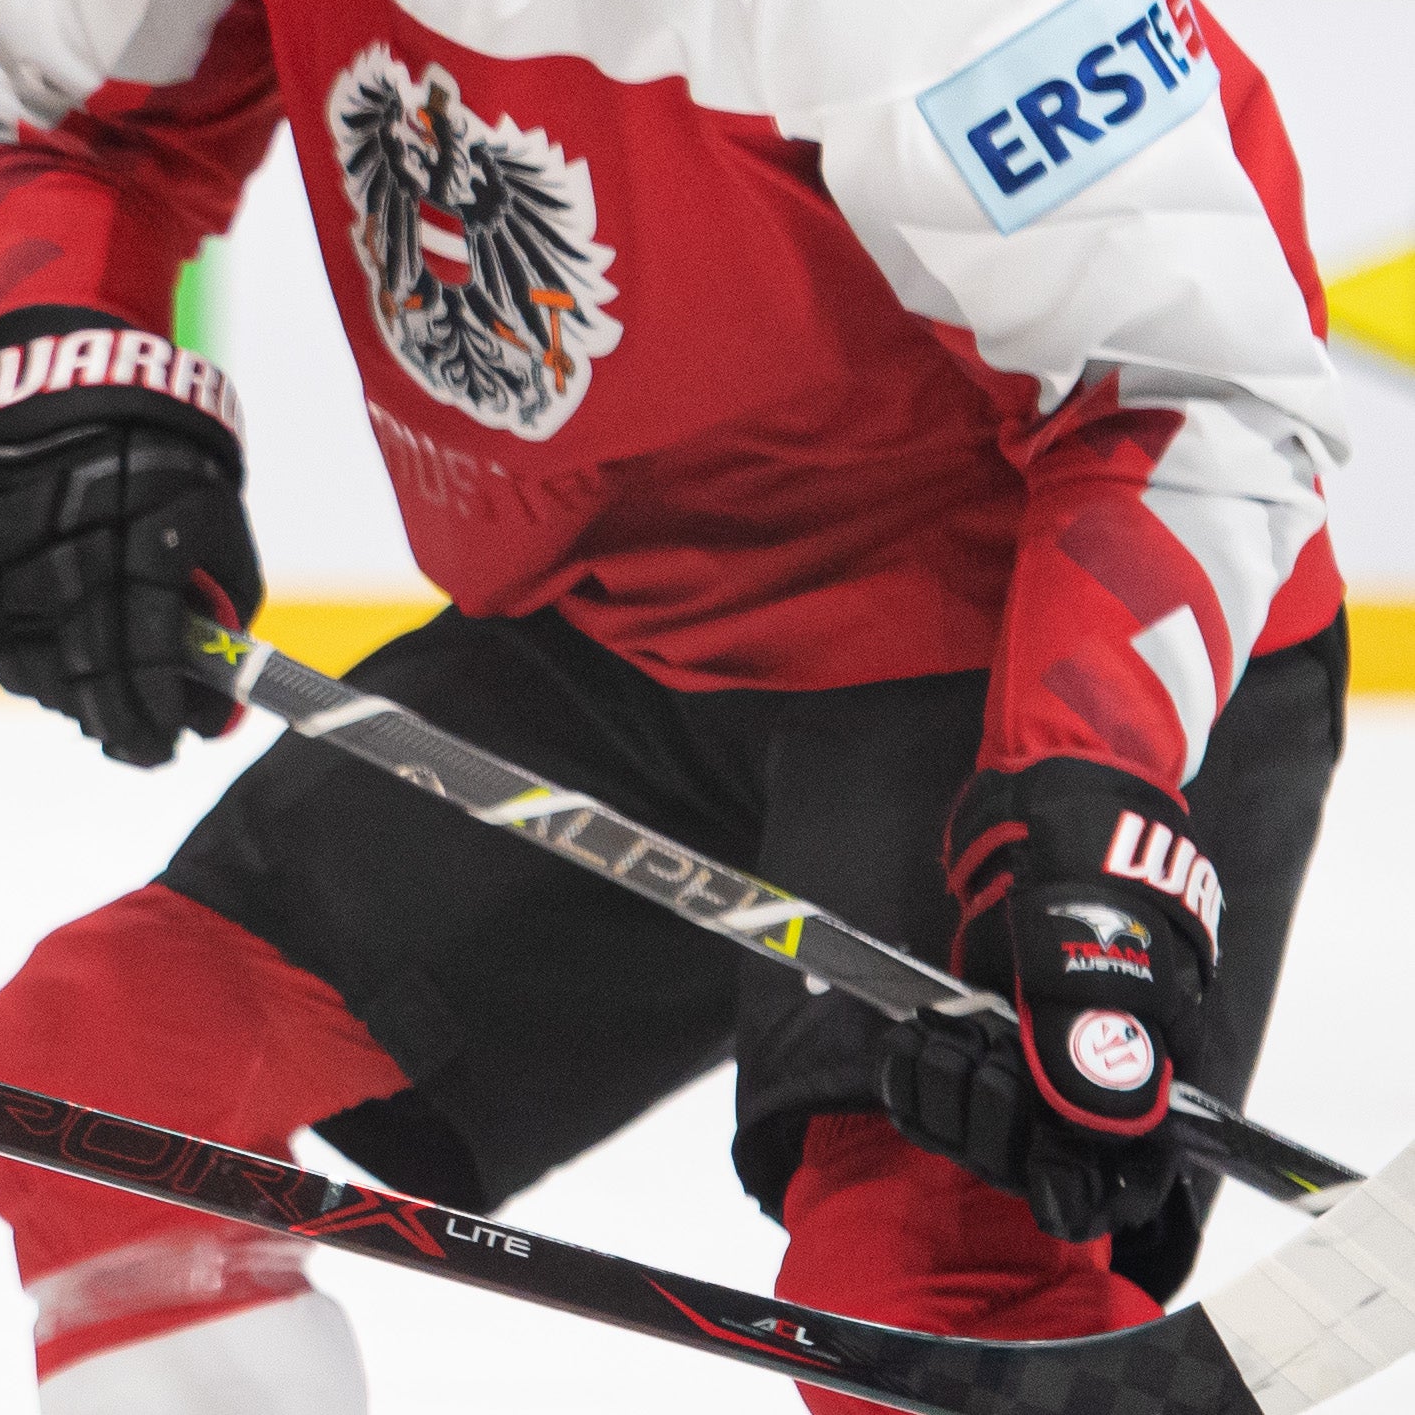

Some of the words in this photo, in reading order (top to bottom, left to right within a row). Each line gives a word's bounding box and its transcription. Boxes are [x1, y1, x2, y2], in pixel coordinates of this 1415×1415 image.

[967, 1, 1191, 196] ERSTE
[1061, 941, 1151, 968] TEAM
[1065, 957, 1154, 983] AUSTRIA
[445, 1218, 531, 1259] LITE
